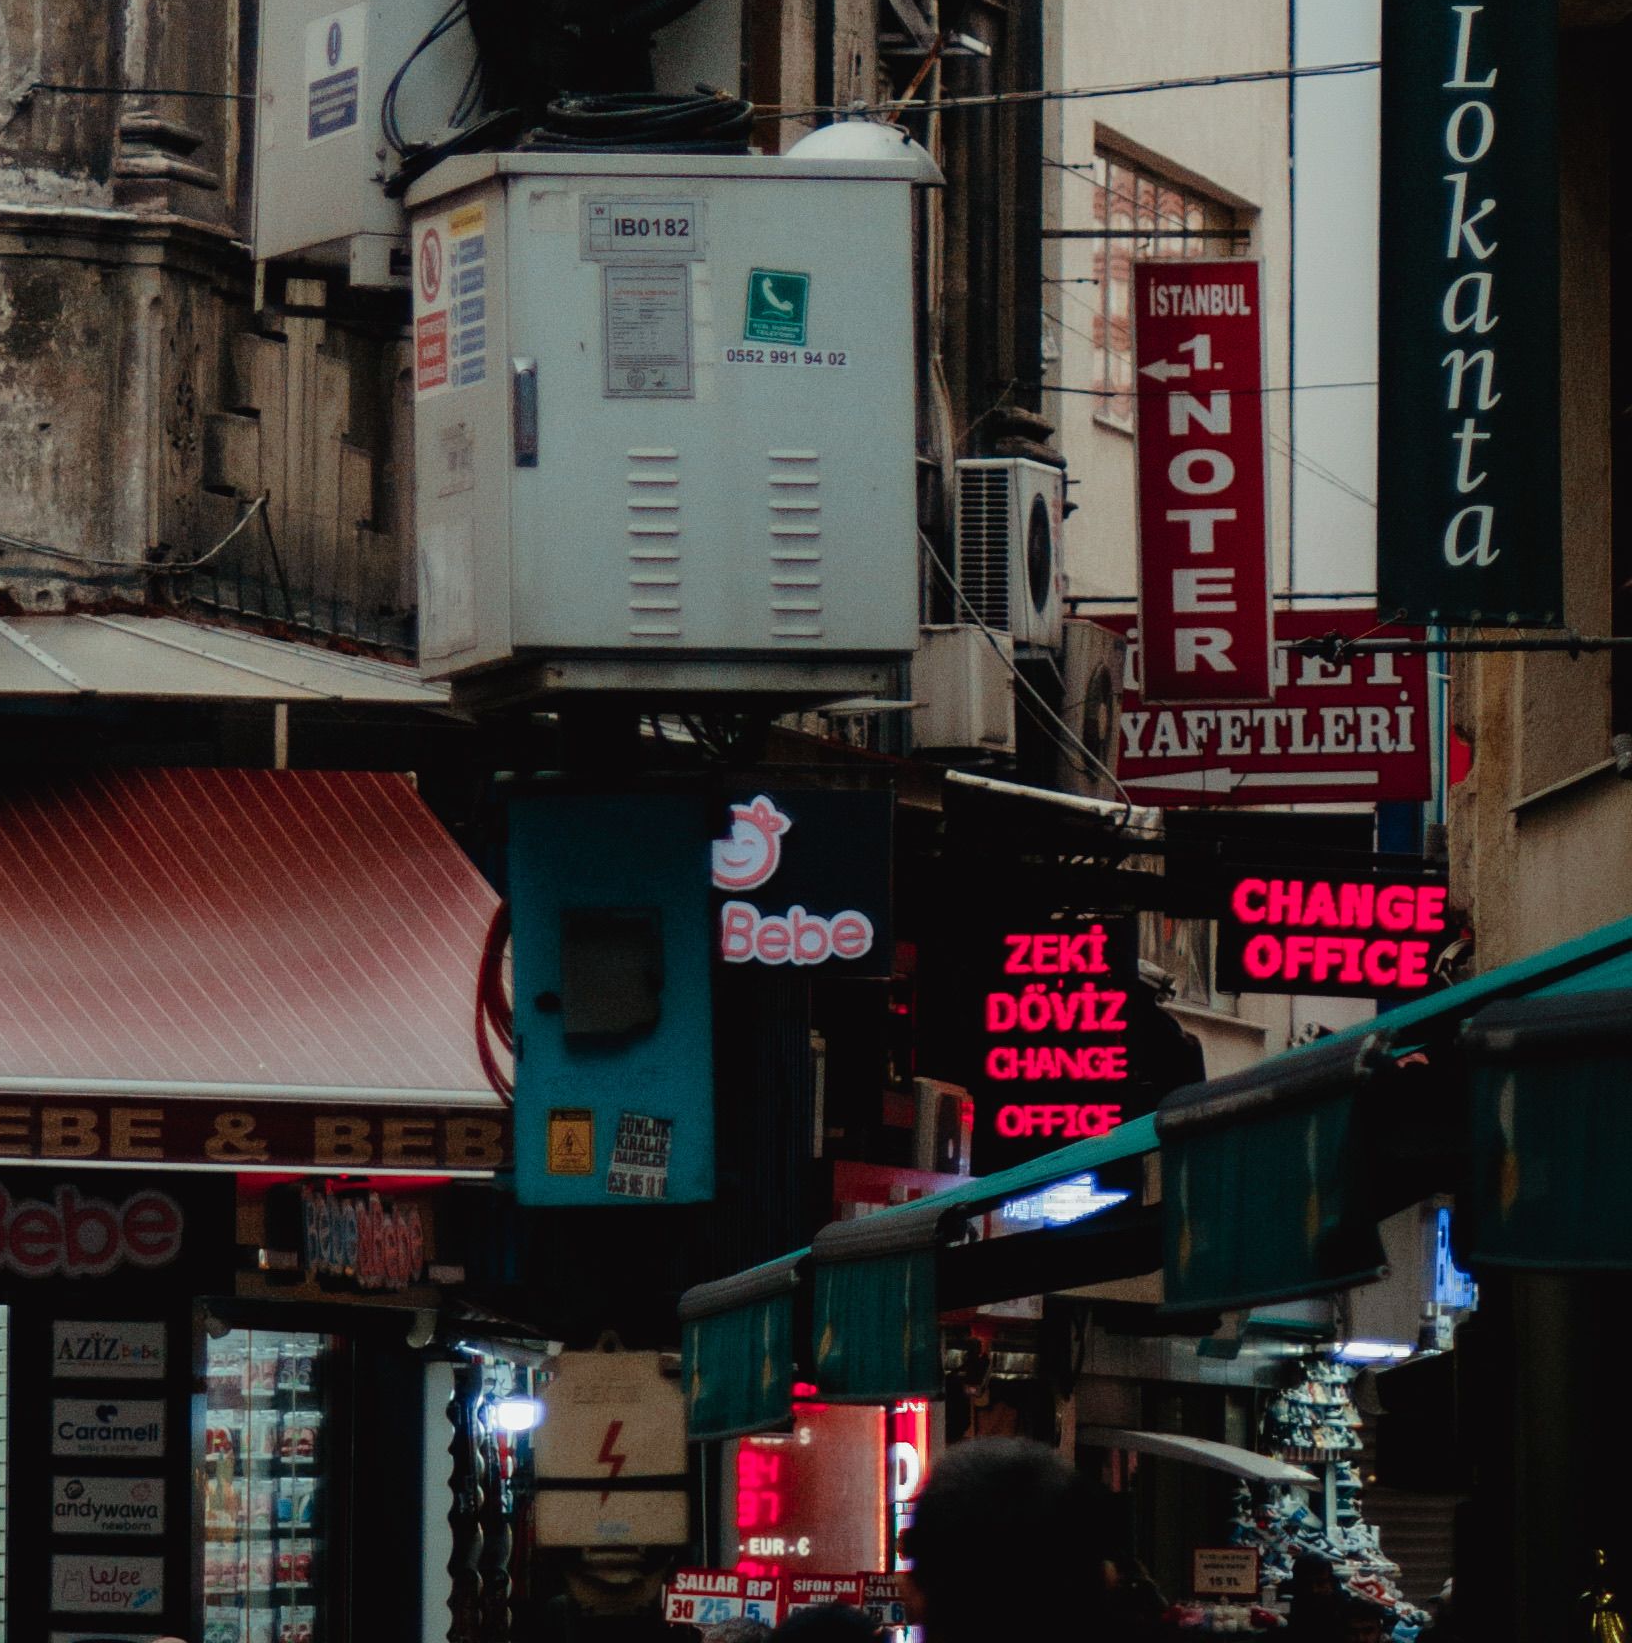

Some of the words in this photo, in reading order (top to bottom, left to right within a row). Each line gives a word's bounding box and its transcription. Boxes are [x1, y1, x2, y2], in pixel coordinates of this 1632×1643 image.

[614, 218, 689, 237] IB0182
[1148, 276, 1252, 317] İSTANBUL
[1442, 5, 1501, 567] Lokanta
[727, 349, 764, 363] 0552
[770, 350, 797, 364] 991
[804, 351, 823, 365] 94
[828, 353, 847, 365] 02
[1177, 335, 1224, 372] 1.
[1168, 391, 1237, 673] NOTER
[1119, 690, 1416, 758] YAFETLERİ
[1232, 878, 1447, 932] CHANGE
[722, 905, 868, 961] Bebe
[1004, 924, 1110, 974] ZEKİ
[1244, 935, 1430, 988] OFFICE
[986, 982, 1127, 1032] DÖVİZ
[986, 1047, 1128, 1079] CHANGE
[204, 1112, 268, 1162] &
[313, 1117, 503, 1166] BEB
[58, 1422, 159, 1441] Caramell
[55, 1498, 158, 1522] andywawa
[749, 1538, 784, 1555] EUR
[90, 1587, 132, 1608] baby
[675, 1573, 739, 1592] ŞALLAR
